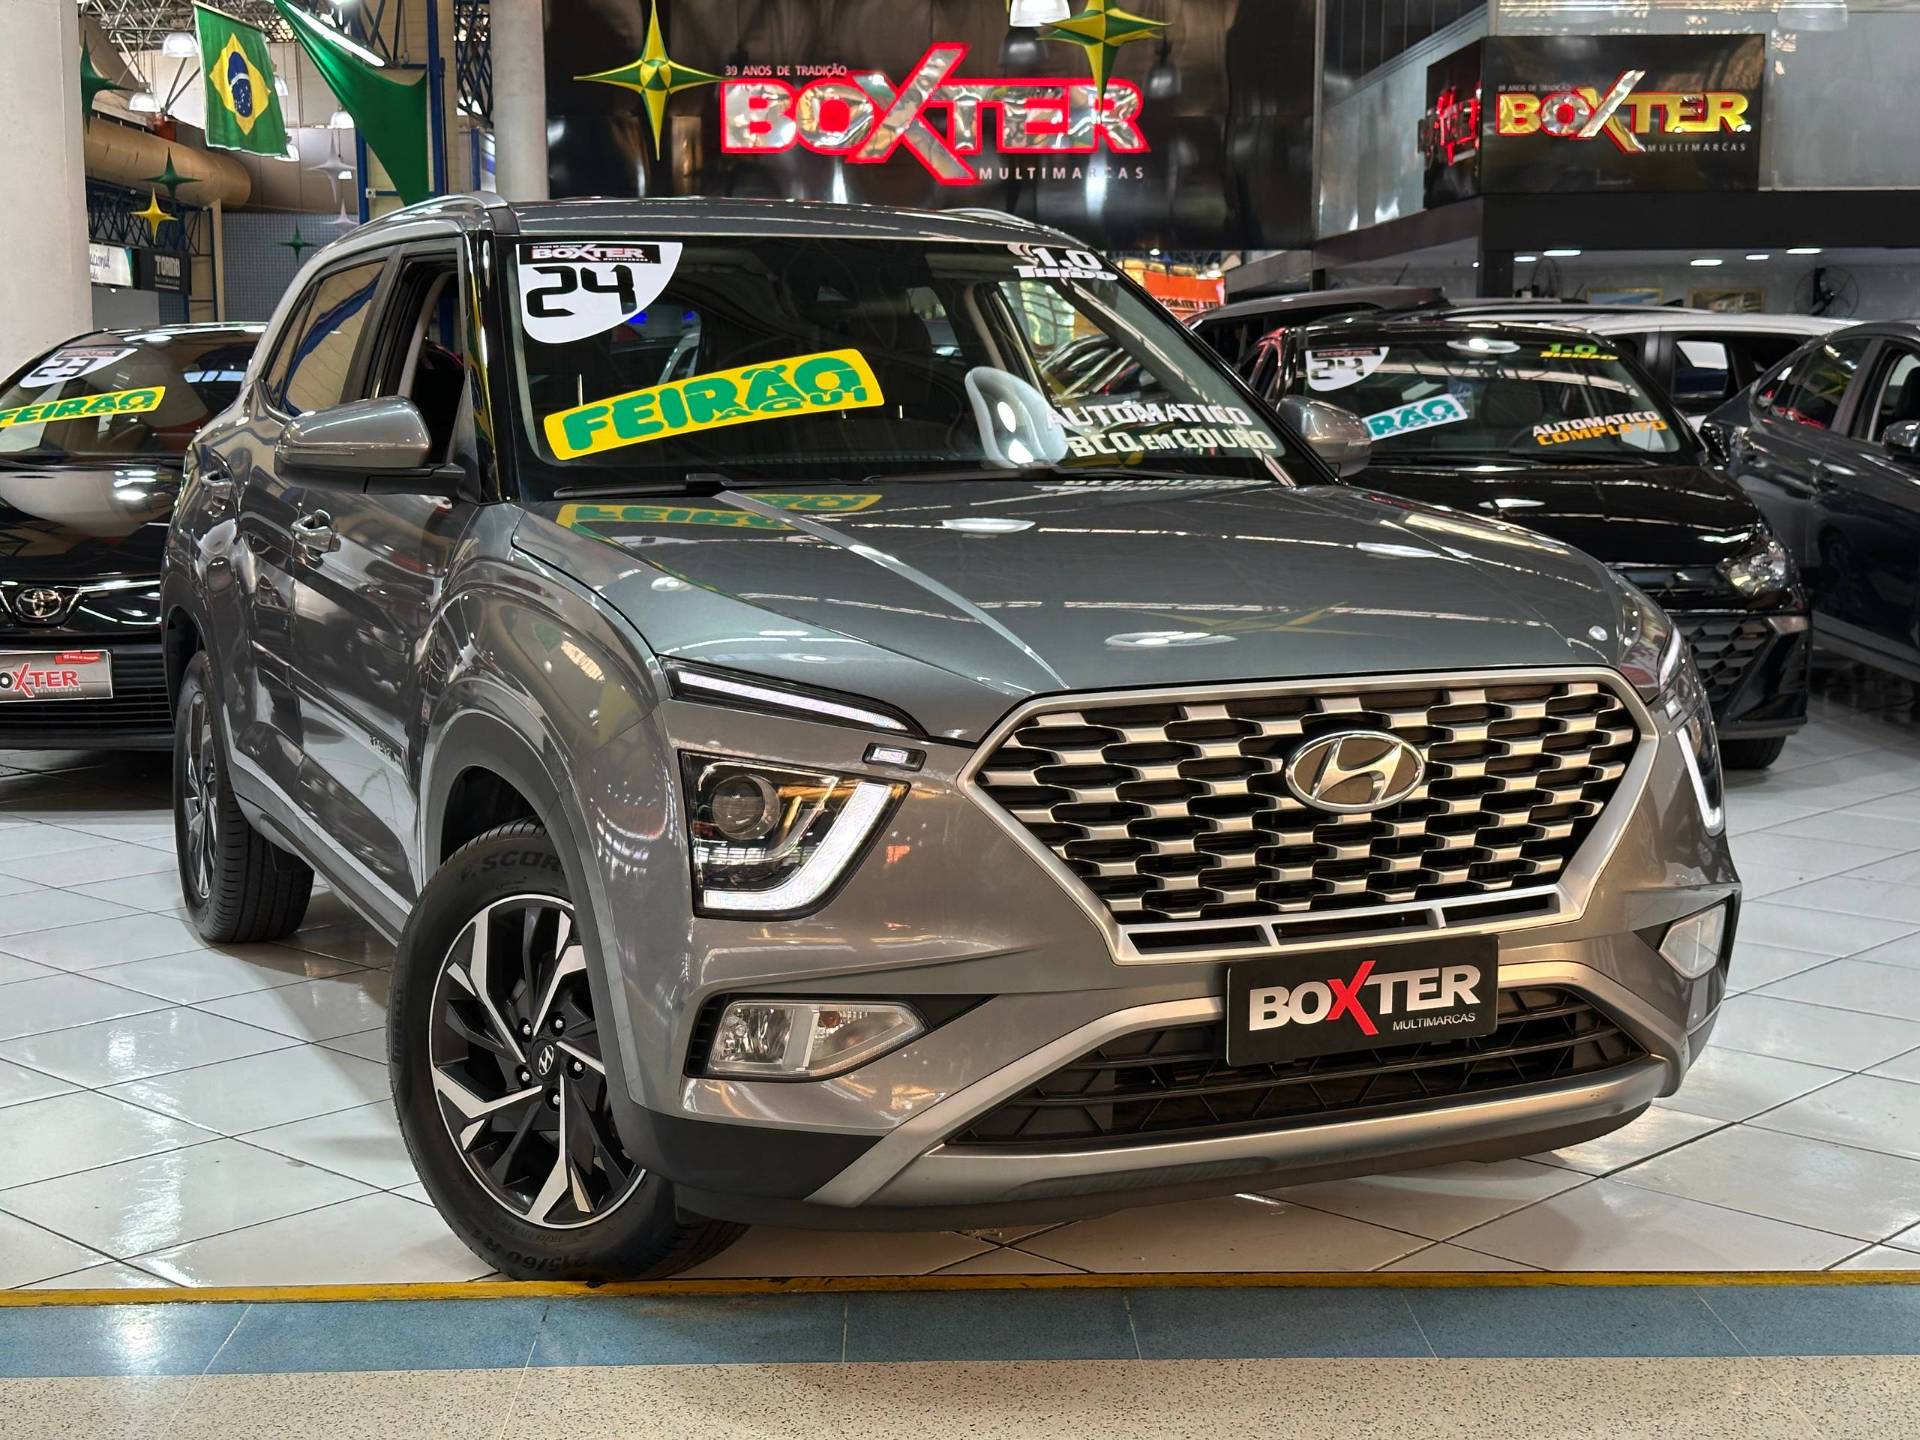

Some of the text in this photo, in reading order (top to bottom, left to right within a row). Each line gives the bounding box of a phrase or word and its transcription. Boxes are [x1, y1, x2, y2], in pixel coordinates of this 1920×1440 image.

[725, 62, 847, 78] 39 ANOS DE TRADIÇÃO
[721, 42, 1152, 186] BOXTER
[1496, 69, 1752, 155] BOXTER
[1646, 142, 1747, 153] MULTIMARCAS
[979, 166, 1145, 180] MULTIMARCAS
[531, 244, 645, 262] BOXTER
[1032, 247, 1103, 270] 1.0
[526, 264, 638, 318] 24
[1549, 343, 1598, 353] 1.0
[30, 357, 98, 378] 23
[1312, 358, 1365, 380] 24
[562, 357, 862, 450] FEIRÃO
[1048, 401, 1254, 429] AUTOMATICO
[1367, 399, 1456, 436] RÃO
[1533, 410, 1661, 438] AUTOMATICO
[1142, 434, 1178, 452] EM
[1173, 428, 1278, 450] COURO
[1536, 420, 1669, 446] COMPLETO
[0, 663, 80, 698] OXTER
[481, 850, 562, 873] SCOR
[1249, 960, 1481, 1036] BOXTER
[1393, 1012, 1477, 1032] MULTIMARCAS
